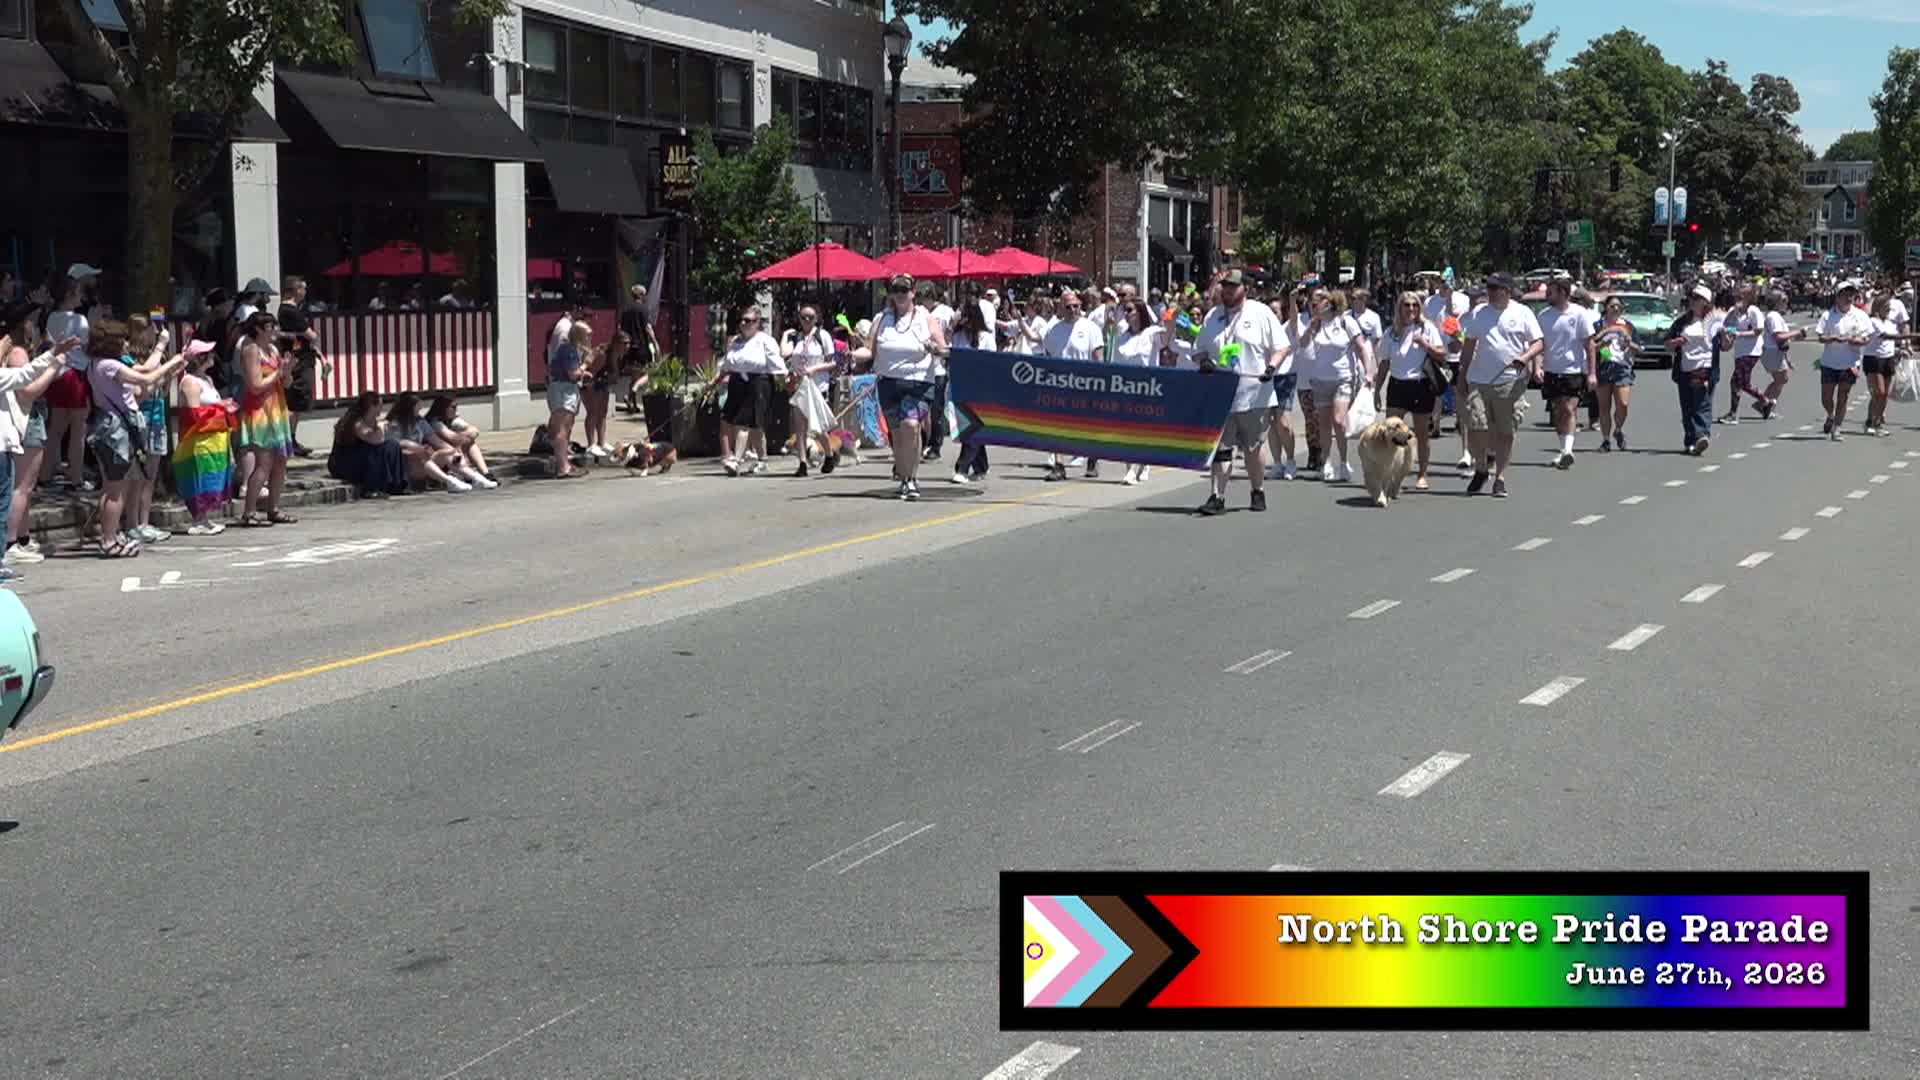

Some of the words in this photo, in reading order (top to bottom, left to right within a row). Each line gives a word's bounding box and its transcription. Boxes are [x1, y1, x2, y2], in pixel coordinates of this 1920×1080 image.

[668, 145, 688, 164] ALL
[663, 165, 698, 184] SOULS
[1034, 367, 1106, 392] Eastern
[1110, 374, 1163, 397] Bank
[1036, 392, 1066, 407] JOIN
[1071, 398, 1089, 409] US
[1093, 400, 1120, 412] FOR
[1125, 402, 1166, 417] GOOD
